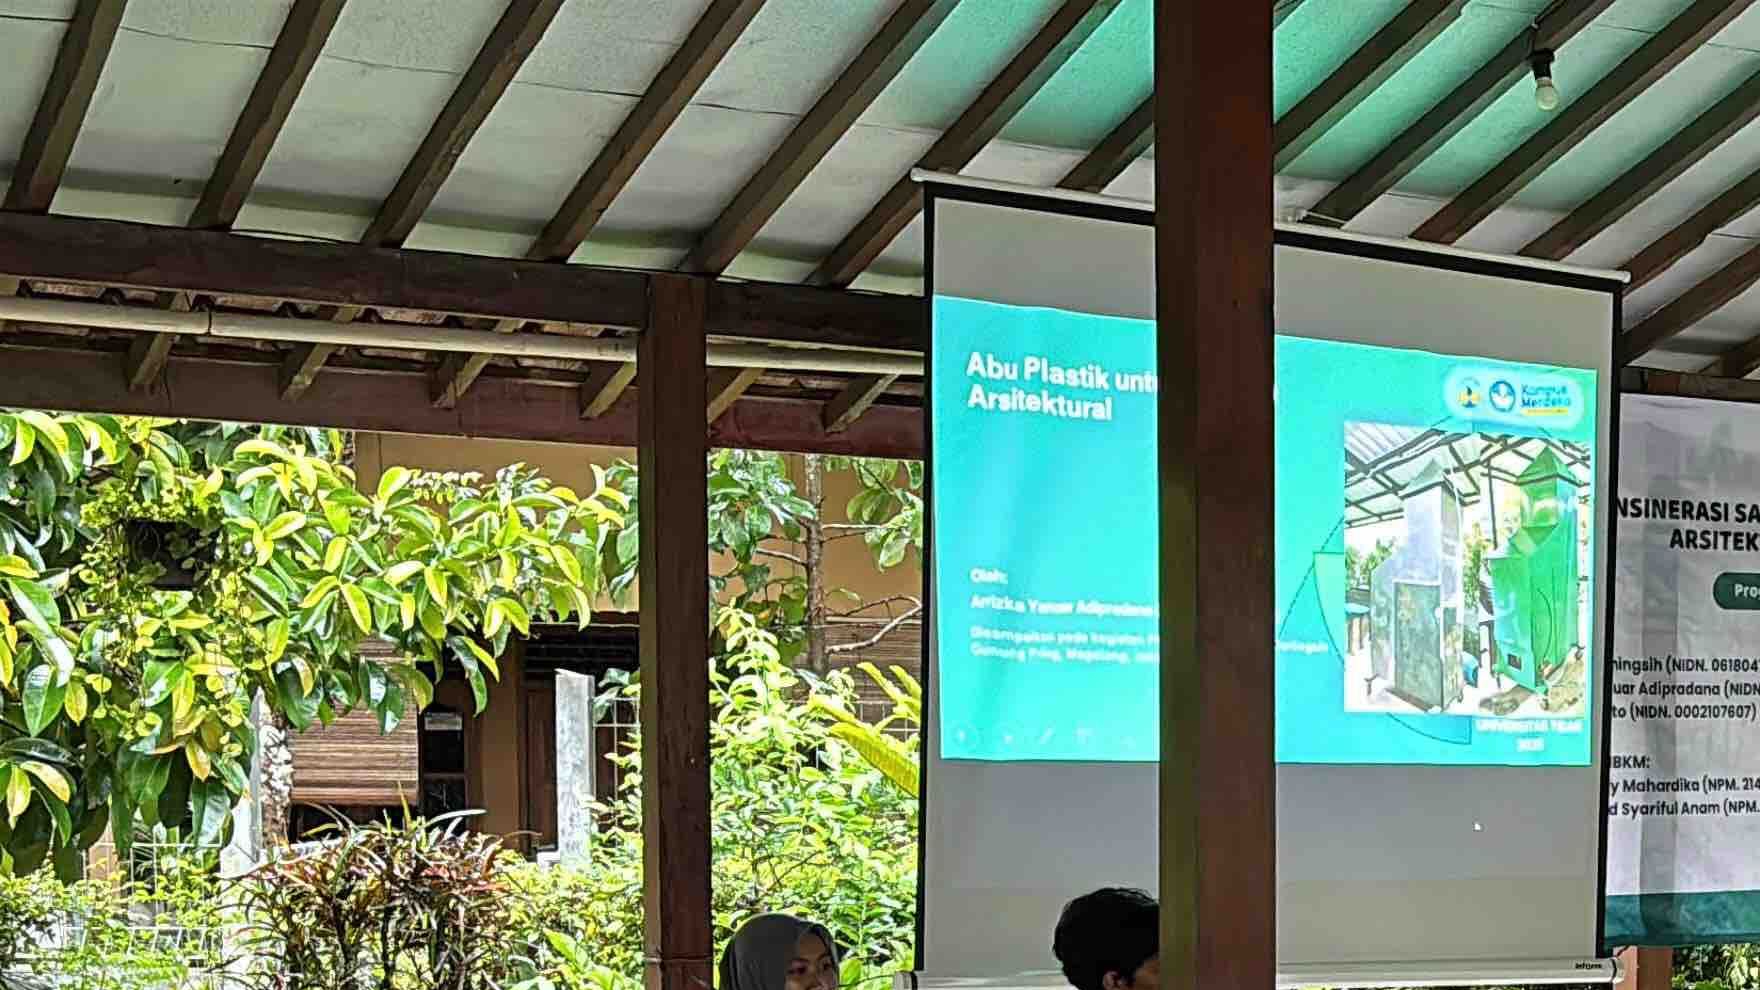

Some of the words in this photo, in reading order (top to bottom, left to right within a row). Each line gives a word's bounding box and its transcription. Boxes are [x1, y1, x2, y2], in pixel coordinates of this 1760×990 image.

[966, 352, 1018, 380] Abu
[1024, 356, 1109, 390] Plastik
[967, 384, 1112, 420] Arsitektural
[1665, 655, 1708, 676] (NIDN.
[1613, 683, 1636, 696] uar
[1638, 680, 1721, 700] Adipradana
[1612, 705, 1626, 719] to
[1630, 701, 1672, 722] (NIDN.
[1675, 702, 1758, 722] 0002107607)
[1610, 755, 1651, 769] BKM:
[1622, 777, 1700, 793] Mahardika
[1702, 773, 1740, 795] (NPM.
[1621, 800, 1679, 820] Syariful
[1681, 800, 1721, 815] Anam
[1723, 797, 1760, 818] (NPM.
